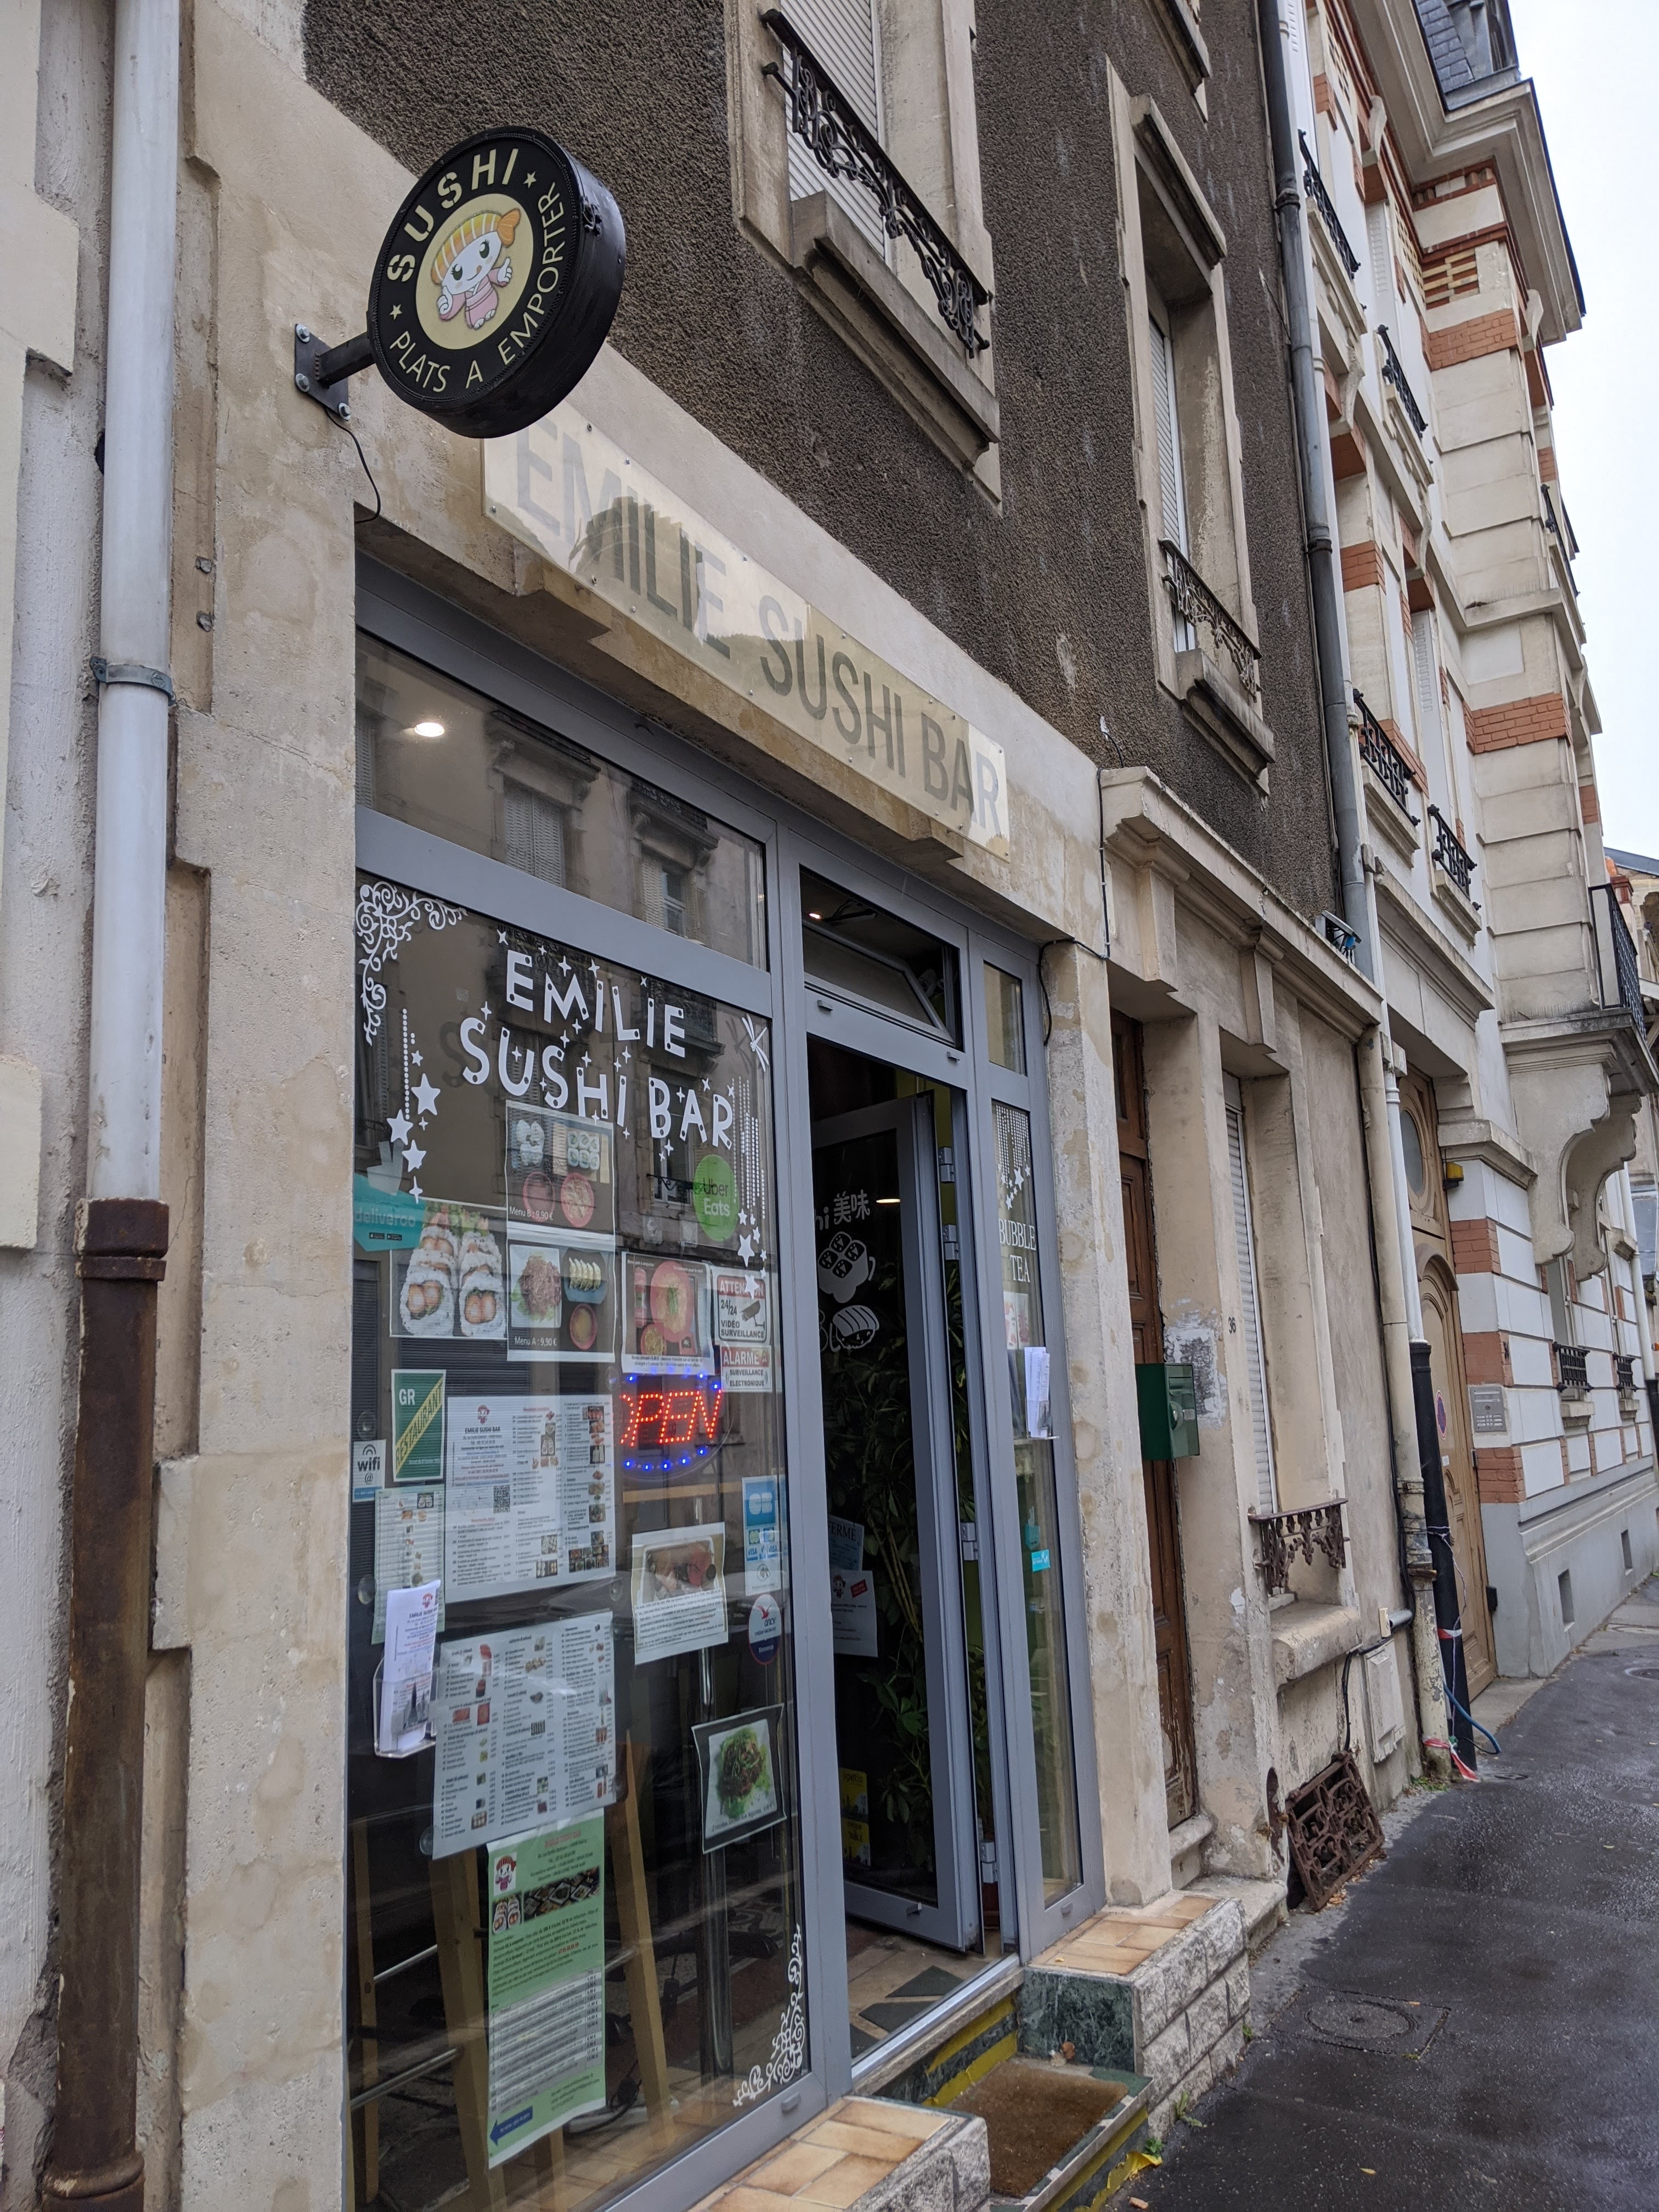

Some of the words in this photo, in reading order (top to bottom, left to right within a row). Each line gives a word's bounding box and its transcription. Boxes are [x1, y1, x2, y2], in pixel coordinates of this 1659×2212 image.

[387, 148, 518, 282] SUSHI
[390, 331, 450, 392] PLATS
[466, 360, 483, 388] A
[498, 182, 566, 365] EMPORTER
[517, 416, 730, 659] EMILIE
[758, 595, 906, 778] SUSHI
[921, 712, 1003, 836] BAR
[506, 949, 686, 1058] EMILIE
[460, 1017, 627, 1127] SUSHI
[648, 1077, 732, 1150] BAR
[703, 1178, 729, 1197] Uber
[509, 1206, 526, 1217] Menu
[535, 1211, 548, 1220] 9,90
[704, 1198, 730, 1217] Eats
[833, 1189, 870, 1224] 美味
[354, 1207, 415, 1227] deliveroo
[998, 1218, 1036, 1251] BUBBLE
[1010, 1255, 1030, 1283] TEA
[720, 1299, 737, 1316] 24/24
[721, 1319, 740, 1328] VIDÉO
[1228, 1317, 1236, 1334] 36
[515, 1336, 531, 1345] Menu
[540, 1338, 552, 1346] 9,90
[721, 1328, 764, 1339] SURVEILLANCE
[723, 1350, 759, 1365] ALARME
[399, 1388, 416, 1406] GR
[396, 1384, 443, 1468] RESTAURANT
[357, 1457, 380, 1471] wifi
[748, 1547, 758, 1556] VISA
